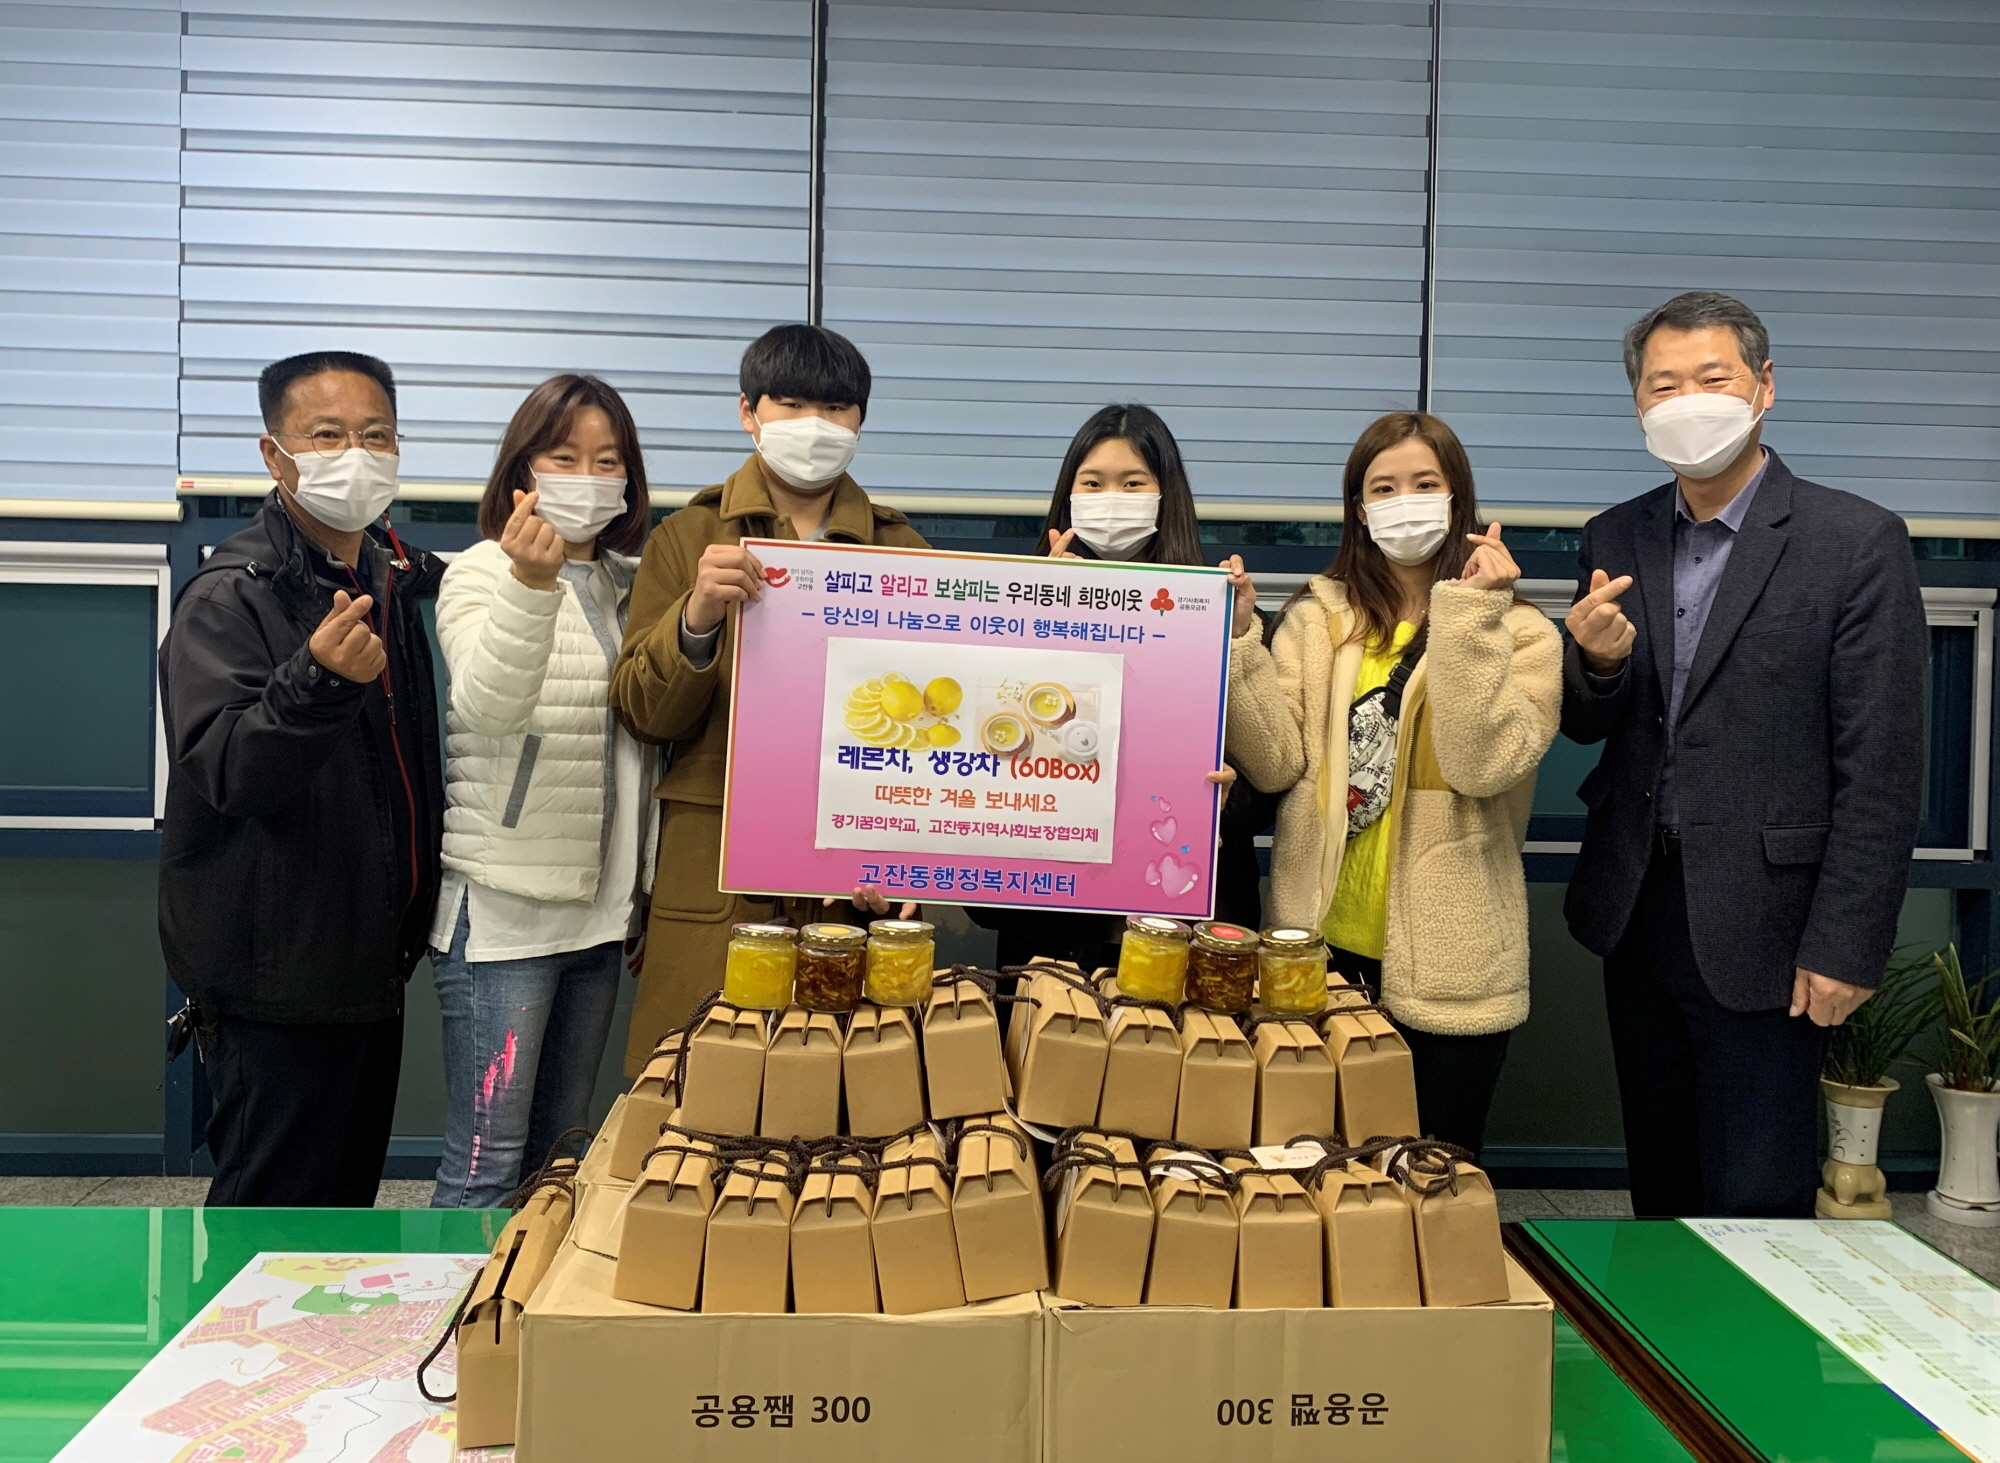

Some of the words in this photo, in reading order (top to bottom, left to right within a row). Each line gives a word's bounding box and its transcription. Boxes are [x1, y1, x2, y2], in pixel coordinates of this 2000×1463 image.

[797, 583, 814, 591] 고잔동
[824, 570, 873, 594] 살피고
[880, 574, 928, 598] 알리고
[934, 578, 1000, 602] 보살피는
[1006, 582, 1071, 607] 우리동네
[1077, 587, 1143, 612] 희망이웃
[1177, 596, 1210, 604] 경기사회복지
[1179, 603, 1207, 611] 공동모금회
[823, 606, 879, 628] 당신의
[887, 610, 962, 632] 나눔으로
[970, 615, 1025, 637] 이웃이
[1033, 618, 1145, 644] 행복해집니다
[838, 745, 913, 774] 레몬차,
[928, 750, 1000, 777] 생강차
[1010, 754, 1100, 784] (60Box)
[875, 785, 932, 806] 따뜻한
[940, 788, 976, 808] 겨울
[985, 791, 1058, 812] 보내세요
[831, 814, 920, 834] 경기꿈의학교,
[928, 819, 1099, 842] 고잔동지역사회보장협의체
[858, 863, 1076, 897] 고잔동행정복지센터
[691, 1395, 793, 1428] 공용쨈
[811, 1396, 871, 1423] 300
[1217, 1398, 1274, 1426] 300
[1291, 1393, 1389, 1426] 공용쨈
